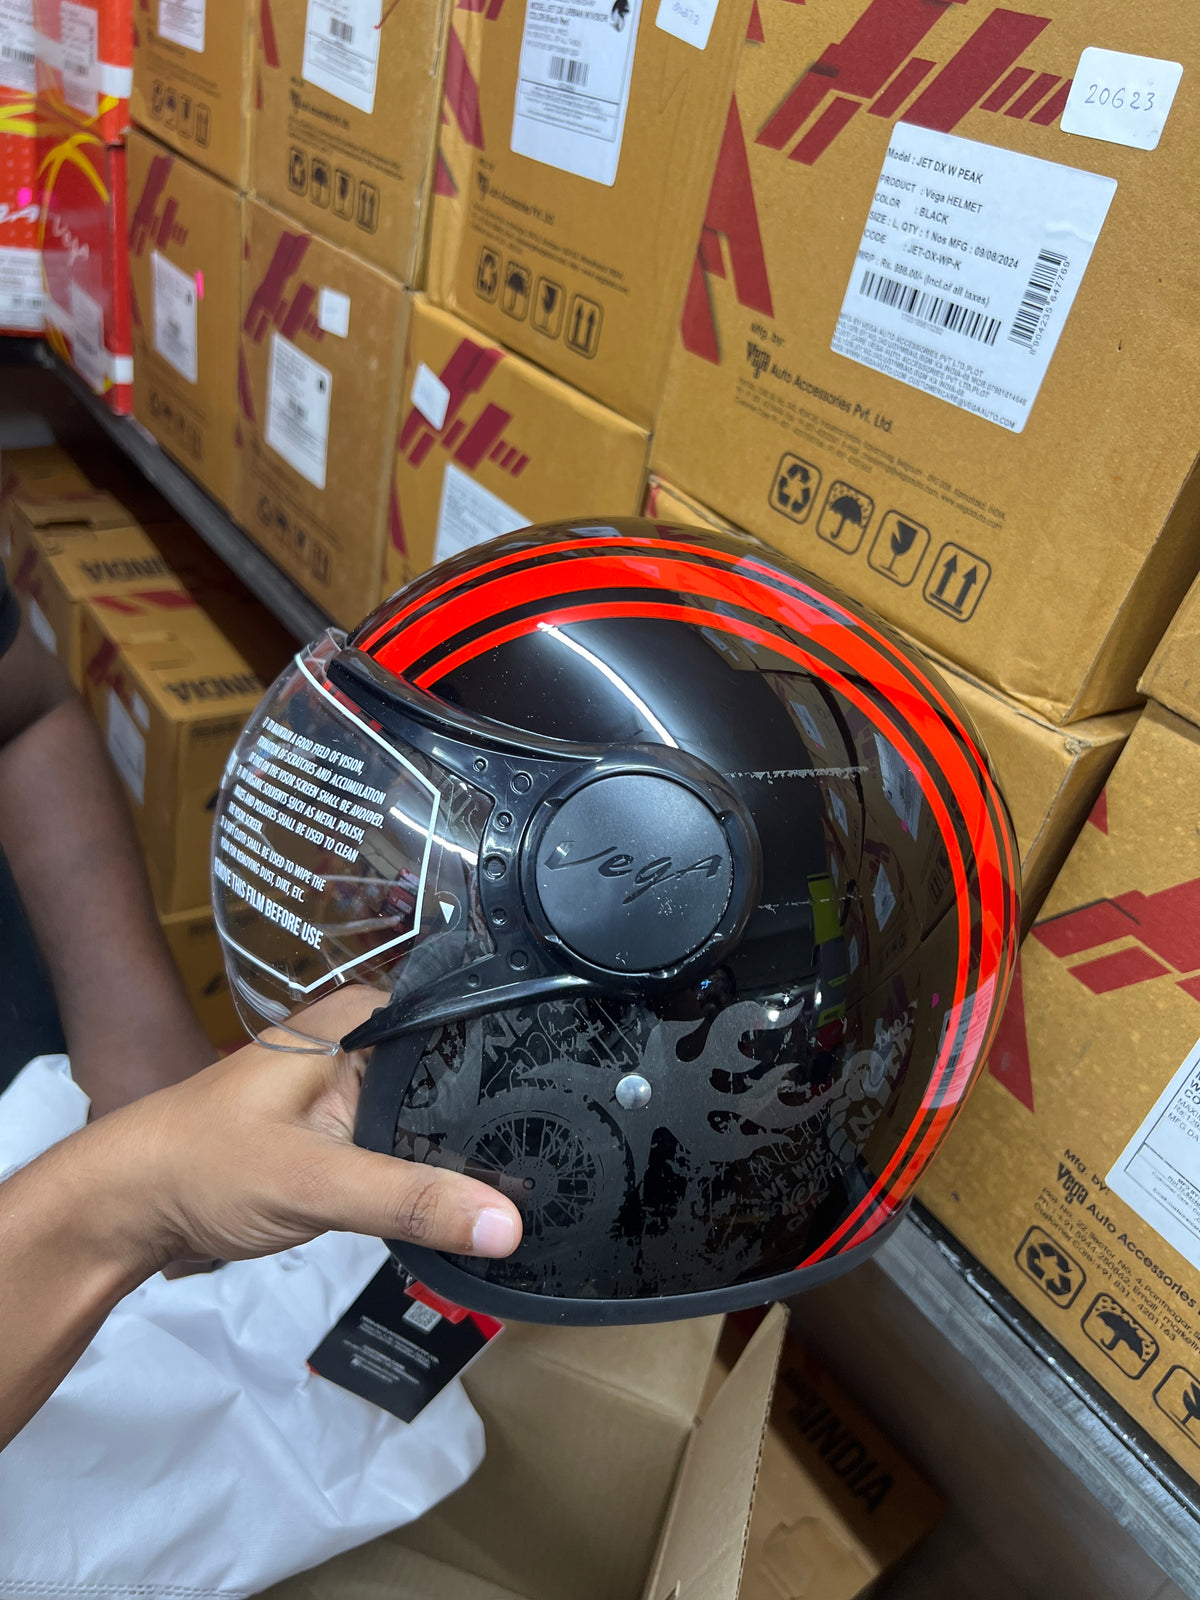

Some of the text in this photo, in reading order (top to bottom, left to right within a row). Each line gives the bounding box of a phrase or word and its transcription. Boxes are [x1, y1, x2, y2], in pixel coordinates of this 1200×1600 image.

[1085, 83, 1156, 112] 20623
[888, 148, 983, 184] Model JET DX W PEAK
[874, 193, 948, 224] COLOR BLACK
[879, 174, 982, 212] PRODUCT Vega HELMET
[864, 229, 961, 269] CODE JET-DX-WP-K
[869, 211, 887, 224] SIZE
[901, 222, 919, 234] QTY
[931, 232, 947, 244] Nos
[948, 238, 968, 251] MFG
[974, 247, 1018, 268] 09/08/2024
[793, 373, 851, 413] Accessories
[277, 748, 288, 759] OF
[285, 752, 317, 774] SCRATCHES
[314, 767, 331, 781] AND
[331, 774, 386, 805] ACCUMULATION
[295, 736, 313, 751] GOOD
[311, 744, 330, 759] FIELD
[328, 750, 341, 763] OF
[338, 755, 364, 775] VISION,
[262, 777, 288, 804] SOLVENTS
[305, 805, 314, 818] AS
[314, 807, 336, 830] METAL
[336, 820, 365, 845] POLISH,
[268, 764, 280, 778] THE
[278, 770, 296, 786] VISOR
[294, 778, 319, 797] SCREEN
[317, 790, 340, 807] SHALL
[339, 799, 352, 813] BE
[350, 804, 384, 829] AVOIDED.
[242, 814, 262, 834] SCREEN.
[244, 793, 255, 806] AND
[253, 799, 278, 820] POLISHES
[276, 812, 296, 830] SHALL
[295, 822, 307, 835] BE
[305, 827, 324, 844] USED
[324, 836, 335, 850] TO
[334, 842, 358, 862] CLEAN
[234, 850, 260, 873] REMOVING
[256, 866, 278, 886] DUST,
[272, 876, 291, 895] DIRT,
[288, 886, 304, 902] ETC.
[243, 836, 264, 854] SHALL
[258, 846, 270, 859] BE
[266, 850, 285, 868] USED
[284, 860, 294, 873] TO
[294, 865, 312, 883] WIPE
[311, 874, 326, 891] THE
[544, 840, 723, 906] Vega
[227, 873, 250, 897] THIS
[241, 886, 269, 911] FILM
[261, 899, 302, 935] BEFORE
[302, 922, 323, 950] USE
[1178, 1098, 1200, 1119] MAXI
[1092, 1172, 1109, 1197] by:
[1042, 1187, 1058, 1204] Plot
[1060, 1204, 1072, 1218] No.
[1089, 1232, 1115, 1258] Sector
[1117, 1260, 1131, 1276] No.
[1144, 1285, 1195, 1334] Pantnagar,
[1057, 1162, 1088, 1205] Vega
[1086, 1204, 1116, 1233] Auto
[1118, 1232, 1197, 1308] Accessories
[1034, 1202, 1071, 1240] Customer
[1114, 1280, 1130, 1297] 831
[1138, 1304, 1175, 1341] 4201163
[1132, 1286, 1158, 1311] Email
[804, 1407, 896, 1515] INDIA
